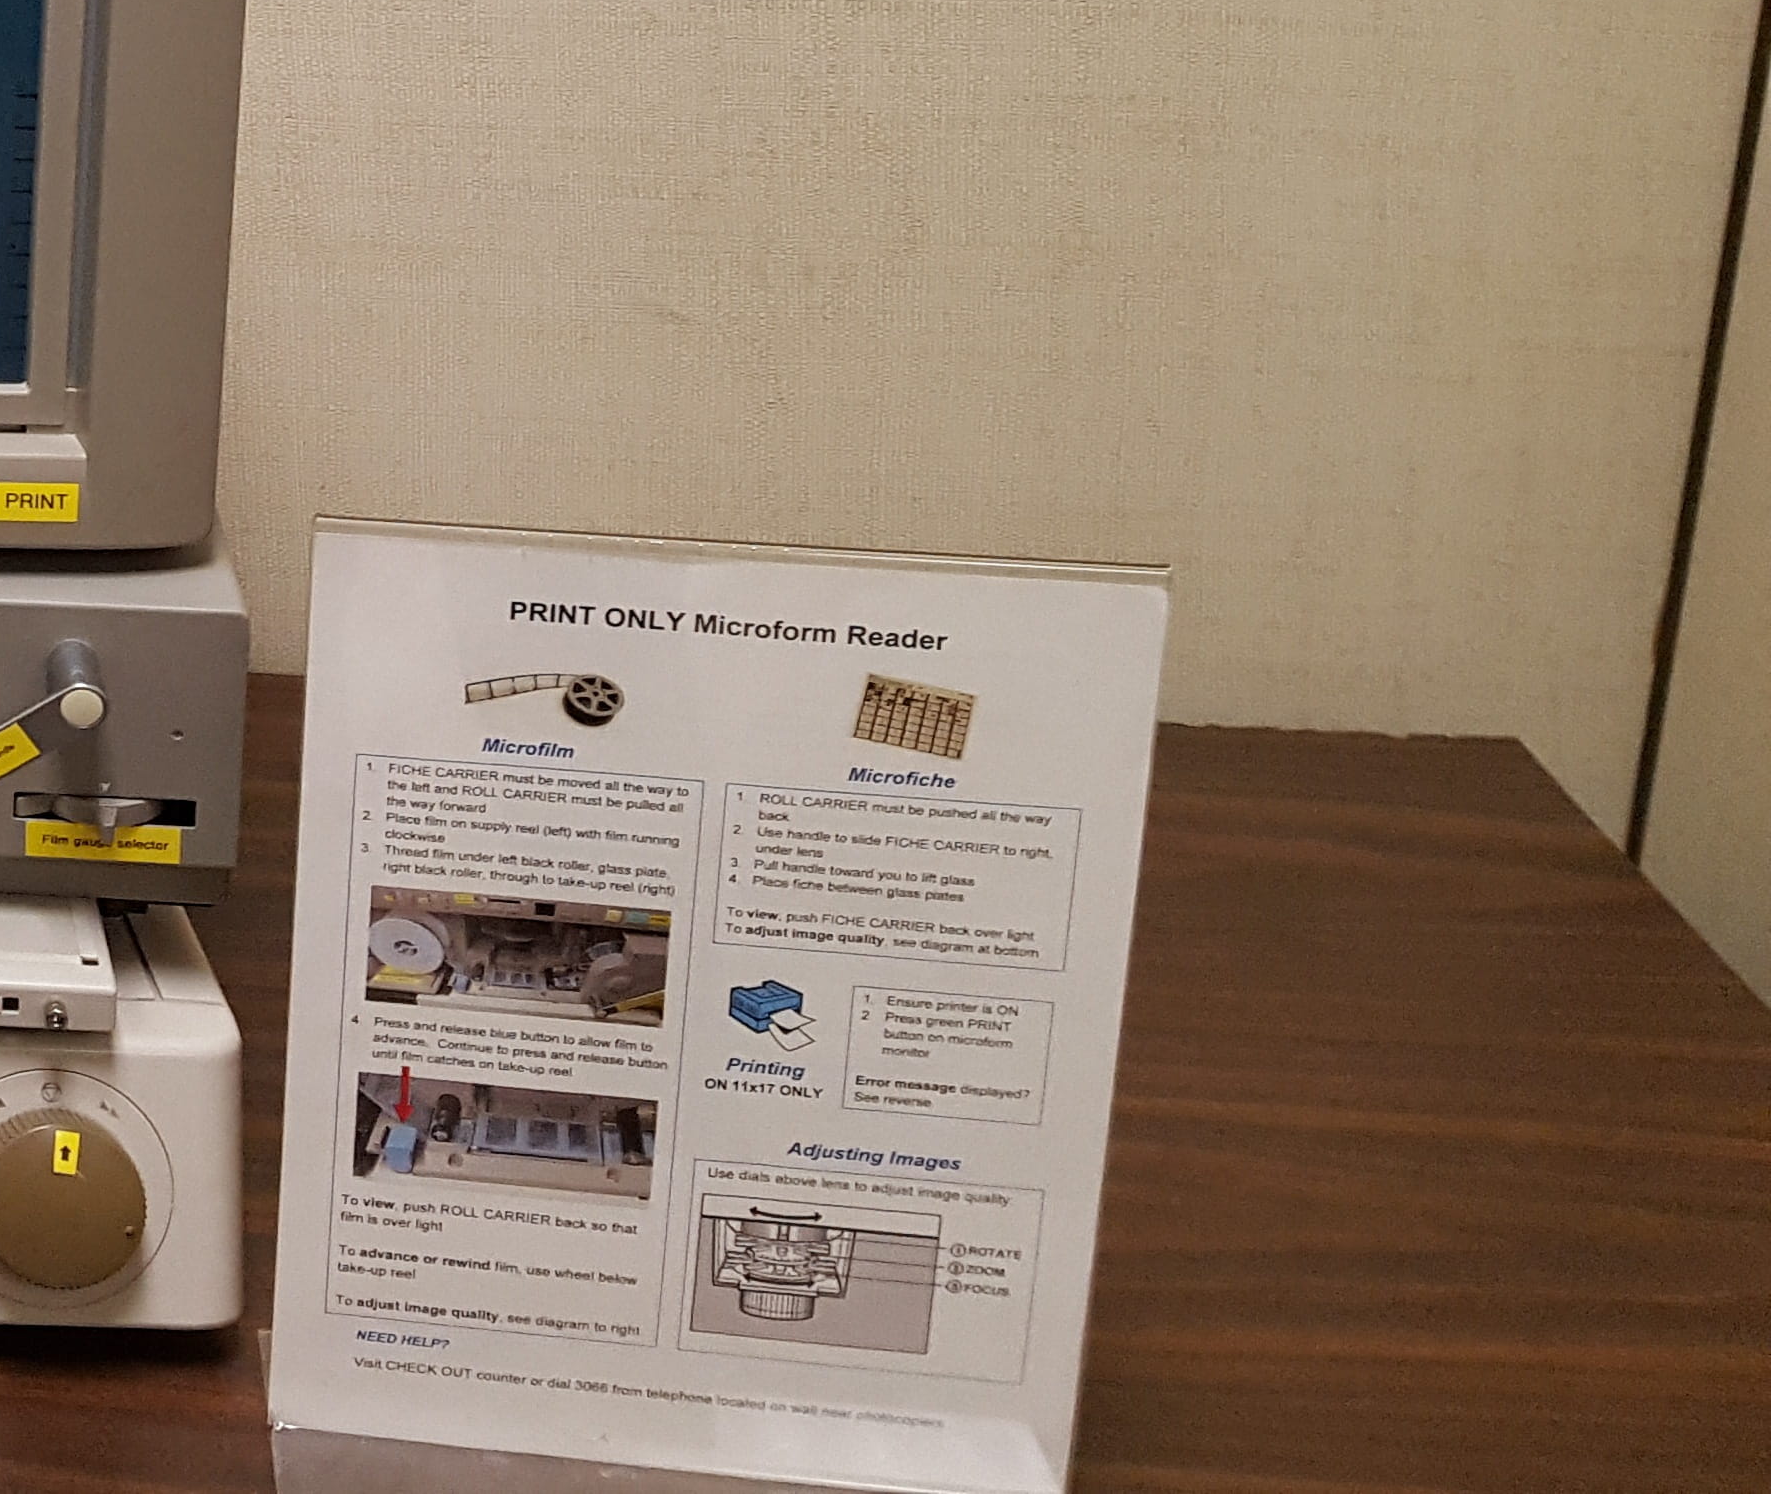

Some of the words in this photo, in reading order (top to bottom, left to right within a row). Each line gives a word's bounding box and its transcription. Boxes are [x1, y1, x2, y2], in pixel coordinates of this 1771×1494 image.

[5, 492, 70, 512] PRINT
[508, 600, 597, 625] PRINT
[603, 606, 687, 632] ONLY
[693, 612, 837, 643] Microform
[846, 624, 949, 651] Reader
[481, 738, 574, 758] Microfilm
[387, 762, 431, 777] FICHE
[434, 766, 499, 781] CARRIER
[501, 773, 535, 784] must
[536, 774, 554, 786] be
[556, 778, 601, 789] moved
[604, 780, 620, 791] all
[622, 782, 644, 793] the
[646, 785, 673, 798] way
[675, 786, 690, 797] to
[847, 767, 955, 788] Microfiche
[386, 779, 407, 791] the
[410, 780, 431, 793] left
[433, 785, 458, 795] and
[461, 784, 498, 798] ROLL
[501, 787, 567, 803] CARRIER
[570, 795, 602, 806] must
[605, 796, 623, 808] be
[624, 799, 665, 811] pulled
[667, 802, 684, 812] all
[42, 834, 69, 845] Film
[117, 839, 169, 850] selector
[725, 1057, 805, 1080] Printing
[703, 1077, 728, 1090] ON
[731, 1080, 776, 1094] 11x17
[778, 1084, 823, 1098] ONLY
[786, 1142, 884, 1166] Adjusting
[889, 1151, 961, 1171] Images
[338, 1243, 356, 1256] To
[358, 1248, 419, 1262] advance
[422, 1255, 438, 1264] or
[441, 1257, 491, 1270] rewind
[525, 1266, 551, 1277] use
[553, 1268, 595, 1280] wheel
[597, 1271, 637, 1285] below
[355, 1329, 397, 1344] NEED
[400, 1334, 450, 1348] HELP?
